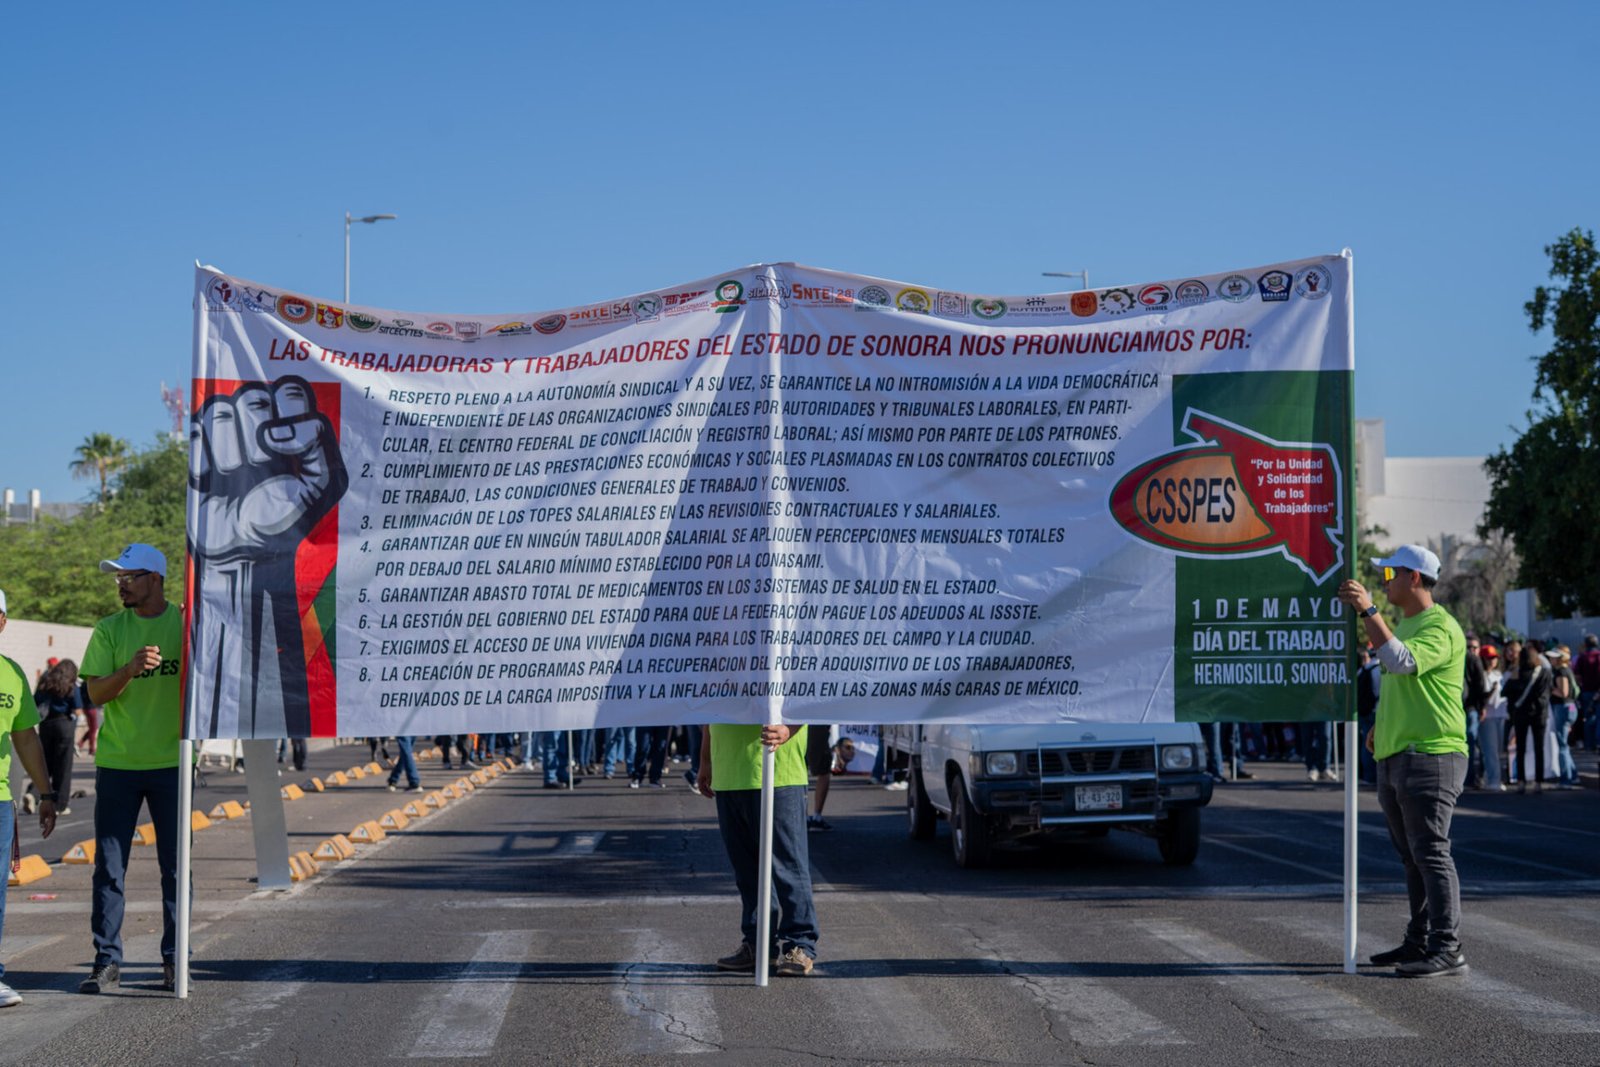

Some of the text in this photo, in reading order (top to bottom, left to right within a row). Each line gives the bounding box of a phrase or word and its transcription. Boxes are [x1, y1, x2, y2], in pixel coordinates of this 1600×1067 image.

[792, 284, 830, 300] SNTE
[613, 303, 631, 315] 54
[379, 326, 424, 338] SITCECYTES
[269, 328, 1252, 374] LAS TRABAJADORAS Y TRABAJADORES DEL ESTADO DE SONORA NOS PRONUNCIAMOS POR:
[388, 369, 1158, 406] RESPETO PLENO AUTONOMÍA SINDICAL VEZ, GARANTICE INTROMISIÓN VIDA DEMOCRÁTICA
[394, 399, 1132, 428] INDEPENDIENTE ORGANIZACIONES SINDICALES AUTORIDADES TRIBUNALES LABORALES, PARTI-
[382, 423, 1122, 455] CULAR, CENTRO FEDERAL CONCILIACIÓN REGISTRO LABORAL; ASÍ MISMO PARTE PATRONES.
[383, 449, 1115, 479] CUMPLIMIENTO PRESTACIONES ECONÓMICAS SOCIALES PLASMADAS CONTRATOS COLECTIVOS
[1276, 459, 1286, 469] la
[1288, 458, 1323, 469] Unidad
[405, 476, 850, 504] TRABAJO, CONDICIONES GENERALES TRABAJO CONVENIOS.
[1258, 473, 1323, 486] y Solidaridad
[1146, 477, 1236, 524] CSSPES
[1274, 488, 1304, 498] de los
[382, 501, 1000, 529] ELIMINACIÓN TOPES SALARIALES LAS REVISIONES CONTRACTUALES SALARIALES.
[381, 527, 1065, 552] GARANTIZAR QUE NINGÚN TABULADOR SALARIAL APLIQUEN PERCEPCIONES MENSUALES TOTALES
[375, 552, 824, 577] POR DEBAJO DEL SALARIO MÍNIMO ESTABLECIDO POR CONASAMI.
[380, 577, 999, 603] GARANTIZAR ABASTO TOTAL MEDICAMENTOS LOS SISTEMAS SALUD ESTADO.
[402, 601, 1041, 629] GESTIÓN DEL GOBIERNO DEL ESTADO PARA QUE FEDERACIÓN PAGUE LOS ADEUDOS ISSSTE.
[1192, 599, 1200, 619] 1
[381, 629, 1035, 655] EXIGIMOS ACCESO UNA VIVIENDA DIGNA PARA LOS TRABAJADORES DEL CAMPO CIUDAD.
[1193, 627, 1345, 651] DÍA DEL TRABAJO
[403, 661, 473, 681] CREACIÓN
[498, 661, 586, 679] PROGRAMAS
[588, 659, 622, 676] PARA
[750, 655, 770, 671] DEL
[775, 656, 818, 672] PODER
[820, 656, 909, 672] ADQUISITIVO
[934, 656, 961, 672] LOS
[966, 655, 1075, 672] TRABAJADORES,
[1194, 662, 1351, 686] HERMOSILLO, SONORA.
[380, 677, 1082, 708] DERIVADOS CARGA IMPOSITIVA INFLACIÓN ACUMULADA LAS ZONAS MÁS CARAS MÉXICO.
